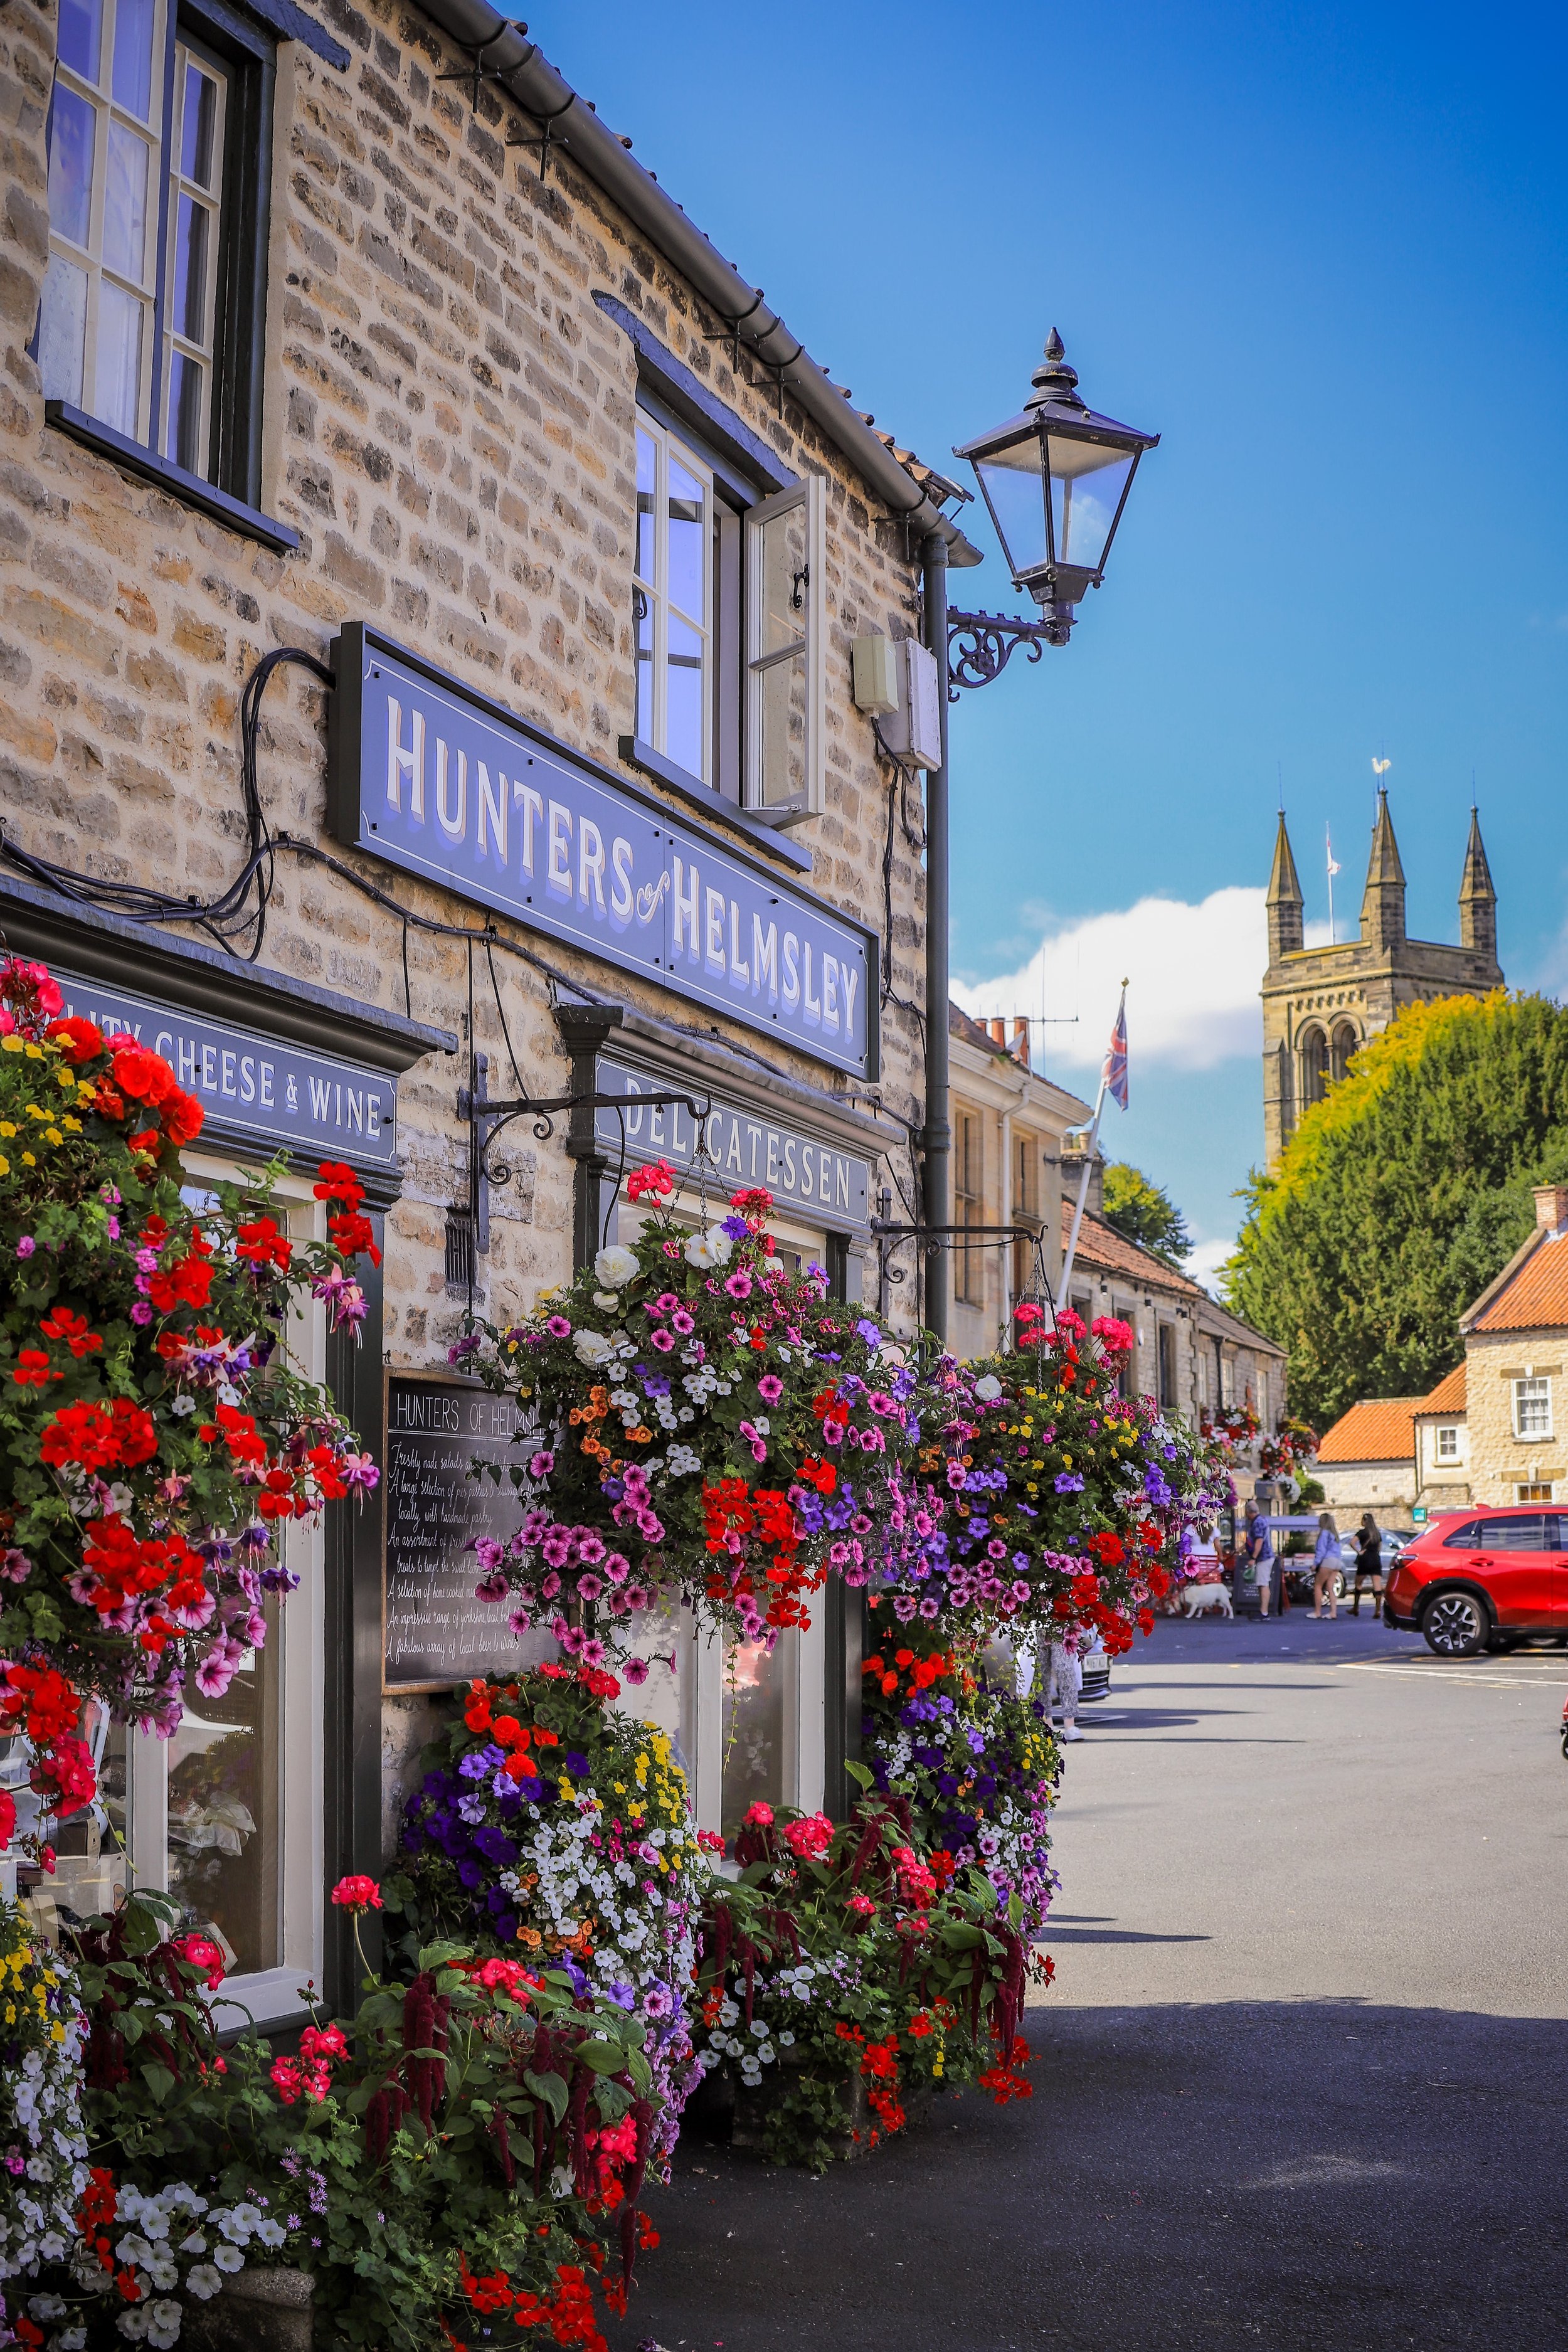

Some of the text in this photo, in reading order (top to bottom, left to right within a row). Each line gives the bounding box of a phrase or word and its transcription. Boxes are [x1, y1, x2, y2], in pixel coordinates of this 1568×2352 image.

[386, 695, 859, 1037] HUNTERS of HELMSLEY
[154, 1031, 381, 1137] CHEESE & WINE
[625, 1077, 850, 1209] DELICATESSEN
[397, 1393, 558, 1440] HUNTERS OF HELMSL
[389, 1441, 421, 1480] Freshly
[423, 1449, 437, 1470] made
[440, 1451, 464, 1471] salads
[388, 1468, 399, 1497] A
[401, 1470, 418, 1505] large
[420, 1475, 445, 1498] selection
[447, 1480, 456, 1507] of
[398, 1499, 421, 1533] locally
[425, 1503, 438, 1523] with
[440, 1502, 469, 1525] handmade
[388, 1522, 400, 1548] An
[402, 1528, 438, 1548] assortment
[440, 1532, 447, 1556] of
[396, 1552, 416, 1574] treats
[417, 1554, 423, 1573] to
[424, 1555, 440, 1582] tempt
[441, 1556, 450, 1573] the
[452, 1556, 466, 1574] sweet
[388, 1574, 396, 1602] A
[397, 1579, 422, 1599] selection
[423, 1582, 432, 1607] of
[433, 1581, 445, 1599] home
[447, 1580, 465, 1599] cooked
[387, 1606, 398, 1631] An
[400, 1611, 432, 1636] impressive
[433, 1611, 450, 1634] range
[452, 1609, 460, 1629] of
[385, 1635, 394, 1661] A
[396, 1637, 424, 1665] fabulous
[426, 1642, 446, 1666] array
[448, 1638, 456, 1660] of
[459, 1634, 475, 1655] local
[479, 1631, 492, 1653] beer
